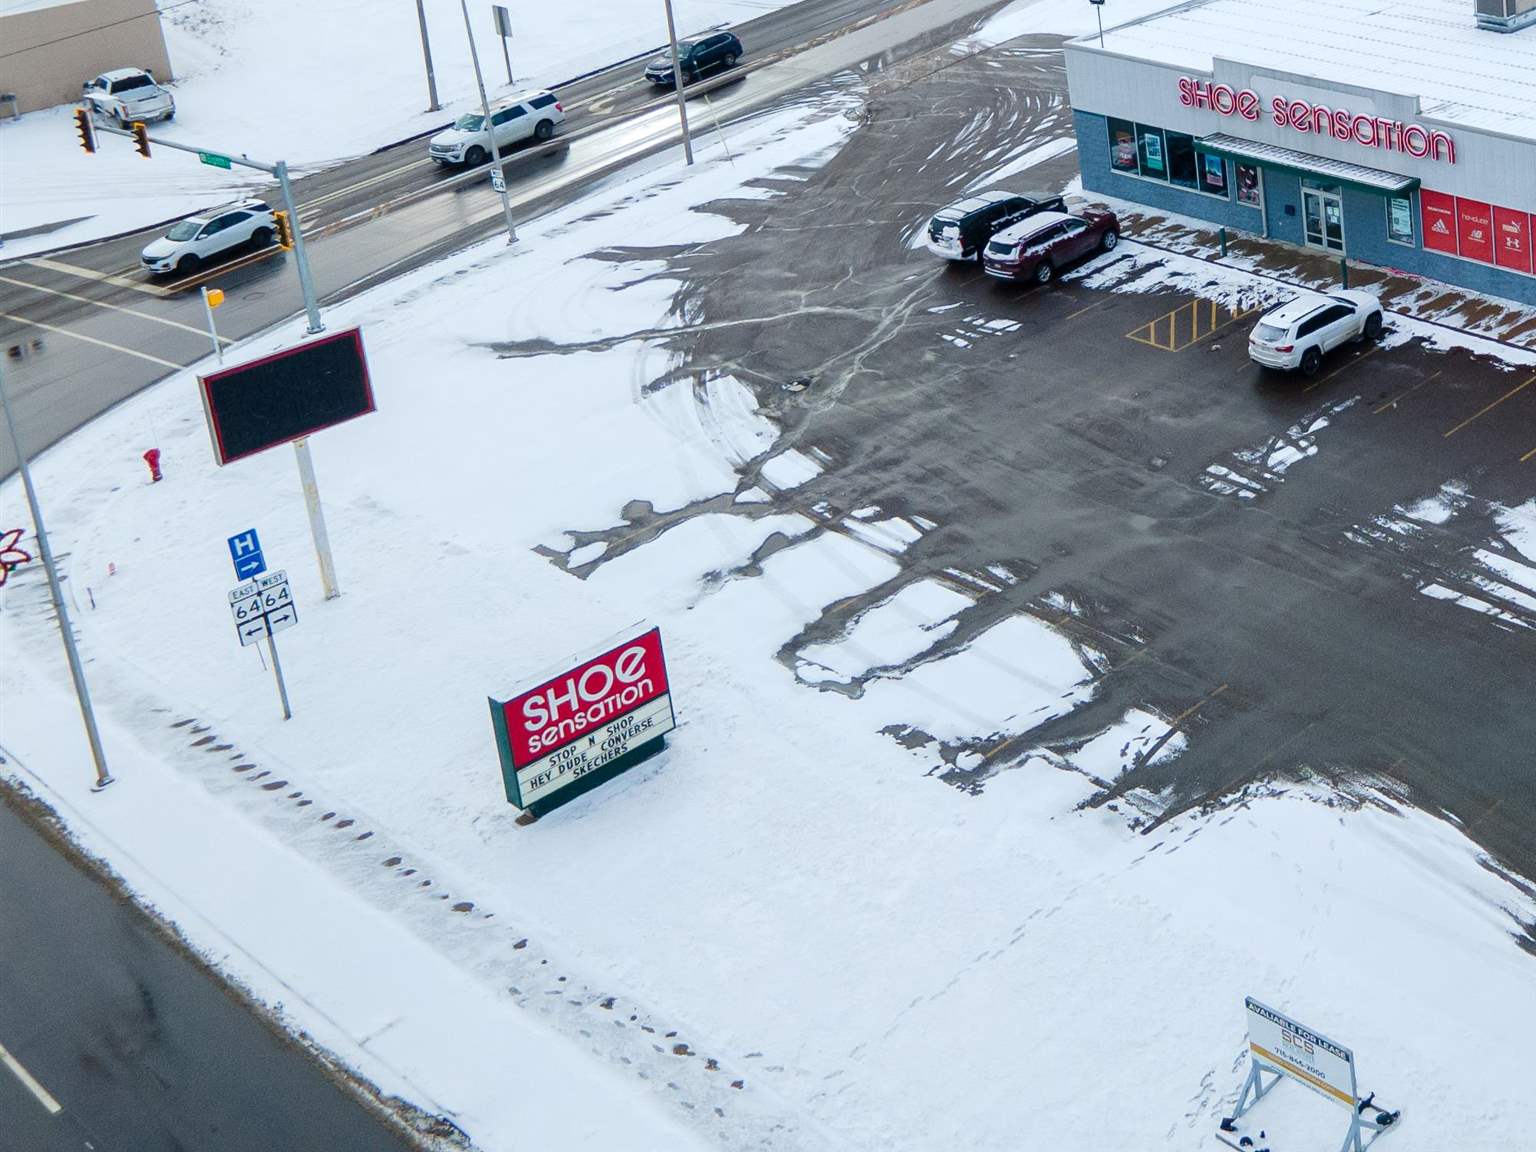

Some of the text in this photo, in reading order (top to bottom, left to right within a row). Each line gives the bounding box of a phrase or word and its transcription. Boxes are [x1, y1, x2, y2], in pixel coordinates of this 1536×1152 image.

[234, 533, 255, 557] H
[261, 574, 284, 587] WEST
[232, 587, 255, 600] EAST
[266, 587, 289, 607] 64
[237, 599, 260, 619] 64
[530, 717, 654, 790] HEY DUDE CONVERSE
[549, 716, 635, 768] STOP N SHOP
[573, 743, 629, 779] SKECHERS
[1298, 1028, 1318, 1044] FOR
[1318, 1038, 1347, 1059] LEASE
